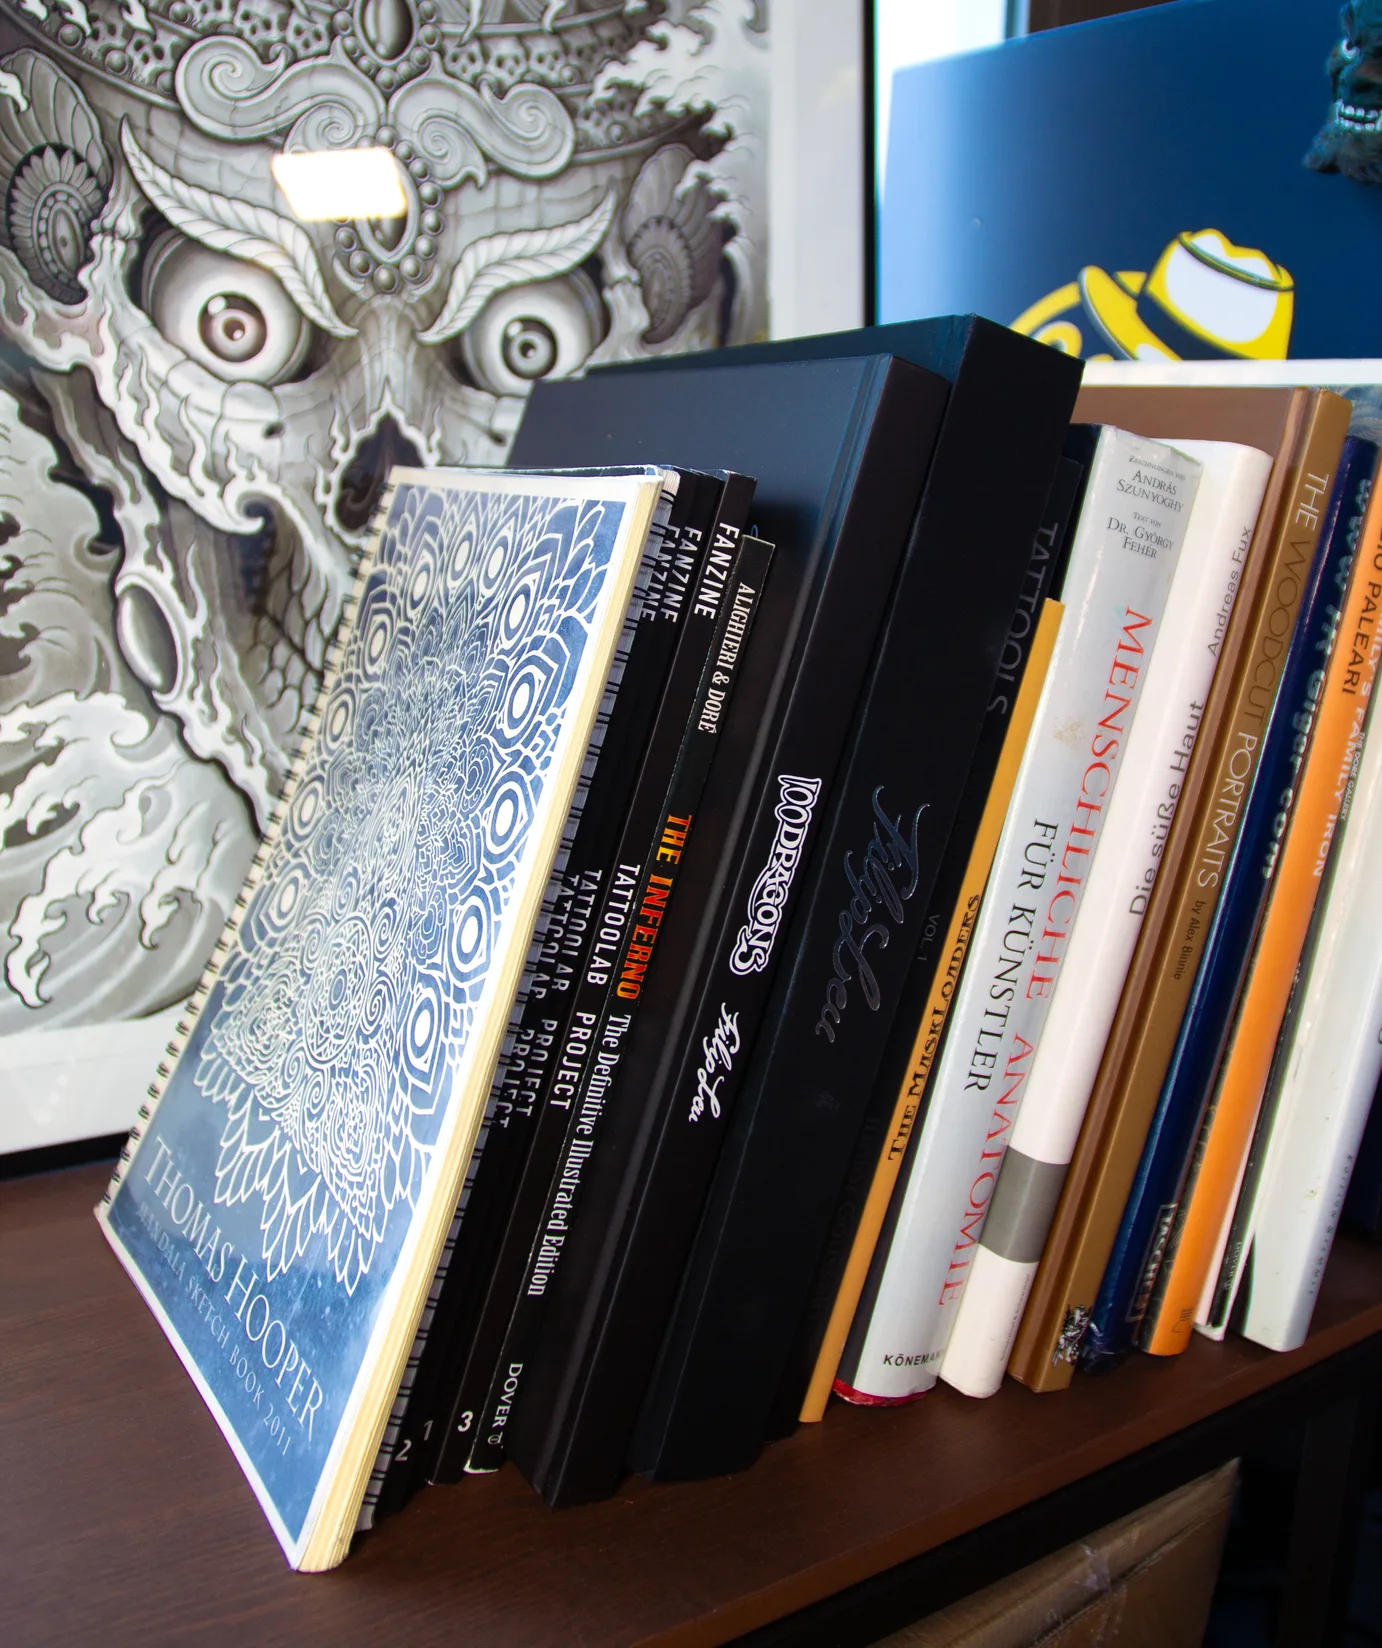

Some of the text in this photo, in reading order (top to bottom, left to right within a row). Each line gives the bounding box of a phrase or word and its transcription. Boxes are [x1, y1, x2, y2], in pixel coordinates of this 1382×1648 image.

[1117, 479, 1184, 512] SZUNYOGHY
[1132, 470, 1177, 495] ANDRÁS
[660, 526, 702, 623] FANZINE
[694, 522, 740, 620] FANZINE
[1107, 516, 1174, 550] DR. GYÖRGY
[1122, 536, 1158, 559] FEHÉR
[715, 582, 756, 670] ALIGHIERI
[1207, 526, 1252, 657] Andreas Fux
[1342, 581, 1382, 695] PALEARI
[711, 671, 730, 686] &
[1198, 473, 1329, 888] THE WOODCUT PORTRAITS
[1334, 706, 1366, 802] FAMILY
[1129, 700, 1205, 916] Die süße Haut
[1313, 814, 1337, 877] IRON
[586, 863, 641, 986] TATTOOLAB
[616, 813, 693, 1000] THE INFERNO
[918, 914, 940, 948] VOL.
[964, 818, 1059, 1091] FÜR KÜNSTLER
[1173, 900, 1207, 980] by Alex Binnie
[938, 605, 1154, 1306] MENSCHLICHE ANATOMIE
[550, 1011, 596, 1110] PROJECT
[527, 1014, 632, 1296] The Definitive Illustrated Edition
[888, 1105, 917, 1161] THE
[136, 1202, 291, 1456] MANDALA SKETCH BOOK 2011
[144, 1136, 323, 1442] THOMAS HOOPER
[423, 1420, 434, 1440] 1
[457, 1411, 474, 1432] 3
[491, 1363, 523, 1428] DOVER
[394, 1439, 412, 1461] 2
